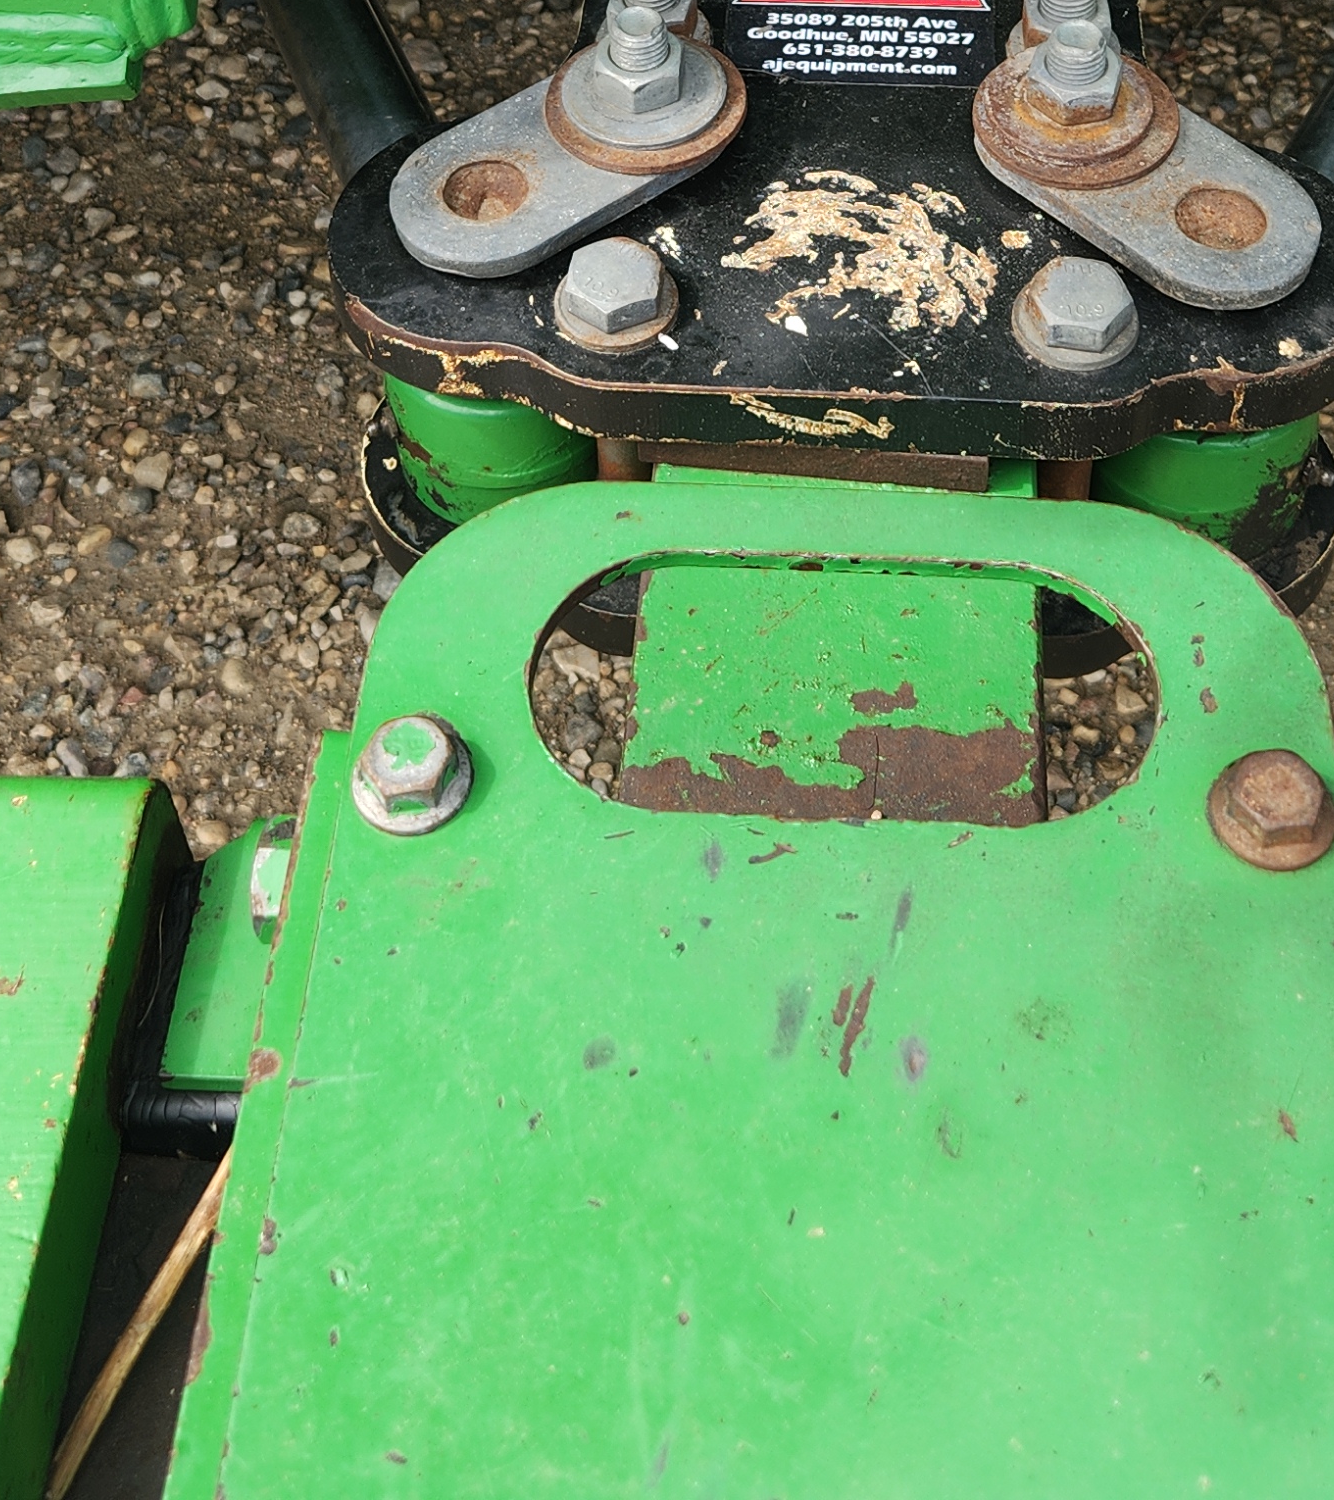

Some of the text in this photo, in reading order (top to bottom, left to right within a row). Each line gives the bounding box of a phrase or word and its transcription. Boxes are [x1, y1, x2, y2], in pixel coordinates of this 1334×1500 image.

[765, 12, 958, 30] 35089 205th Ave
[747, 26, 975, 45] Goodhue, MN 55027
[782, 43, 939, 60] 651-380-8739
[761, 57, 958, 76] ajequipment.com
[584, 276, 620, 299] 10.9
[1065, 303, 1105, 318] 10.9
